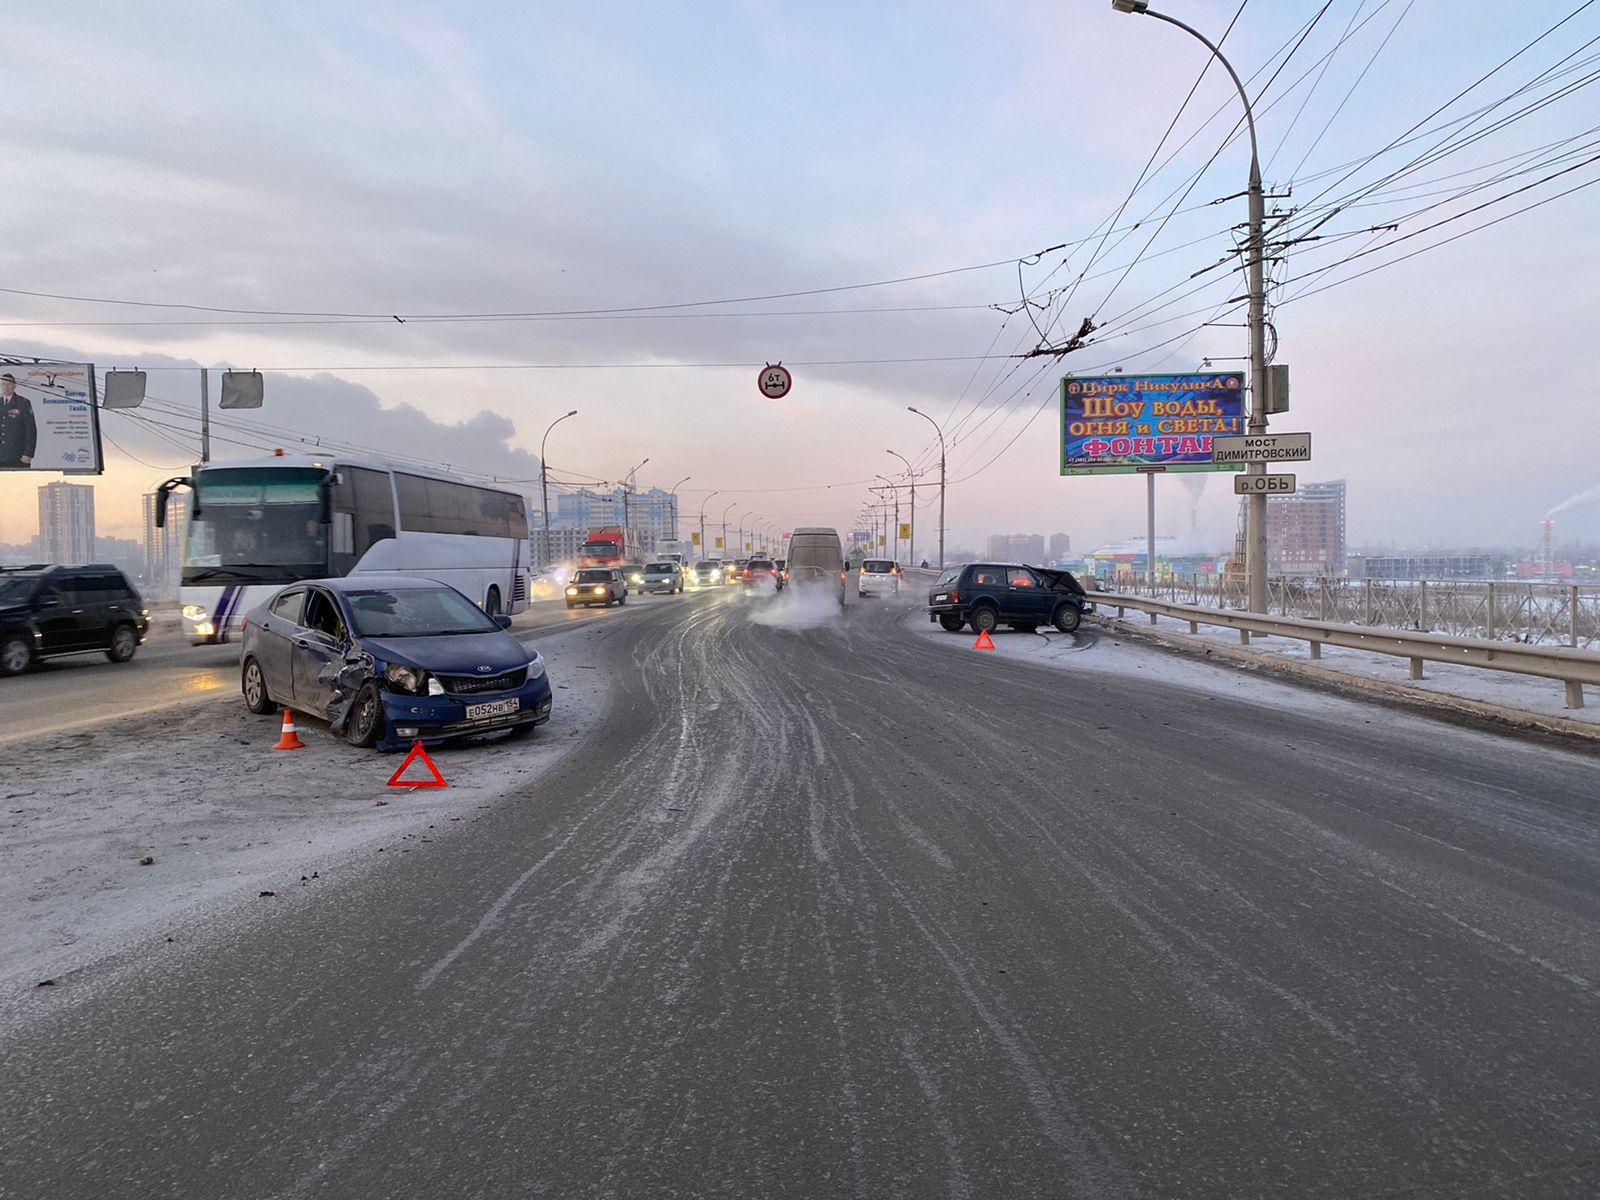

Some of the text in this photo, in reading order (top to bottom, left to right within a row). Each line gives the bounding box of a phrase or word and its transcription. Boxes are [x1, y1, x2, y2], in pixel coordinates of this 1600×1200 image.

[1082, 382, 1128, 396] Цирк
[1069, 420, 1129, 436] ОГНЯ
[1245, 438, 1278, 448] МОСТ
[1216, 445, 1307, 462] ДИМИТРОВСКИЙ
